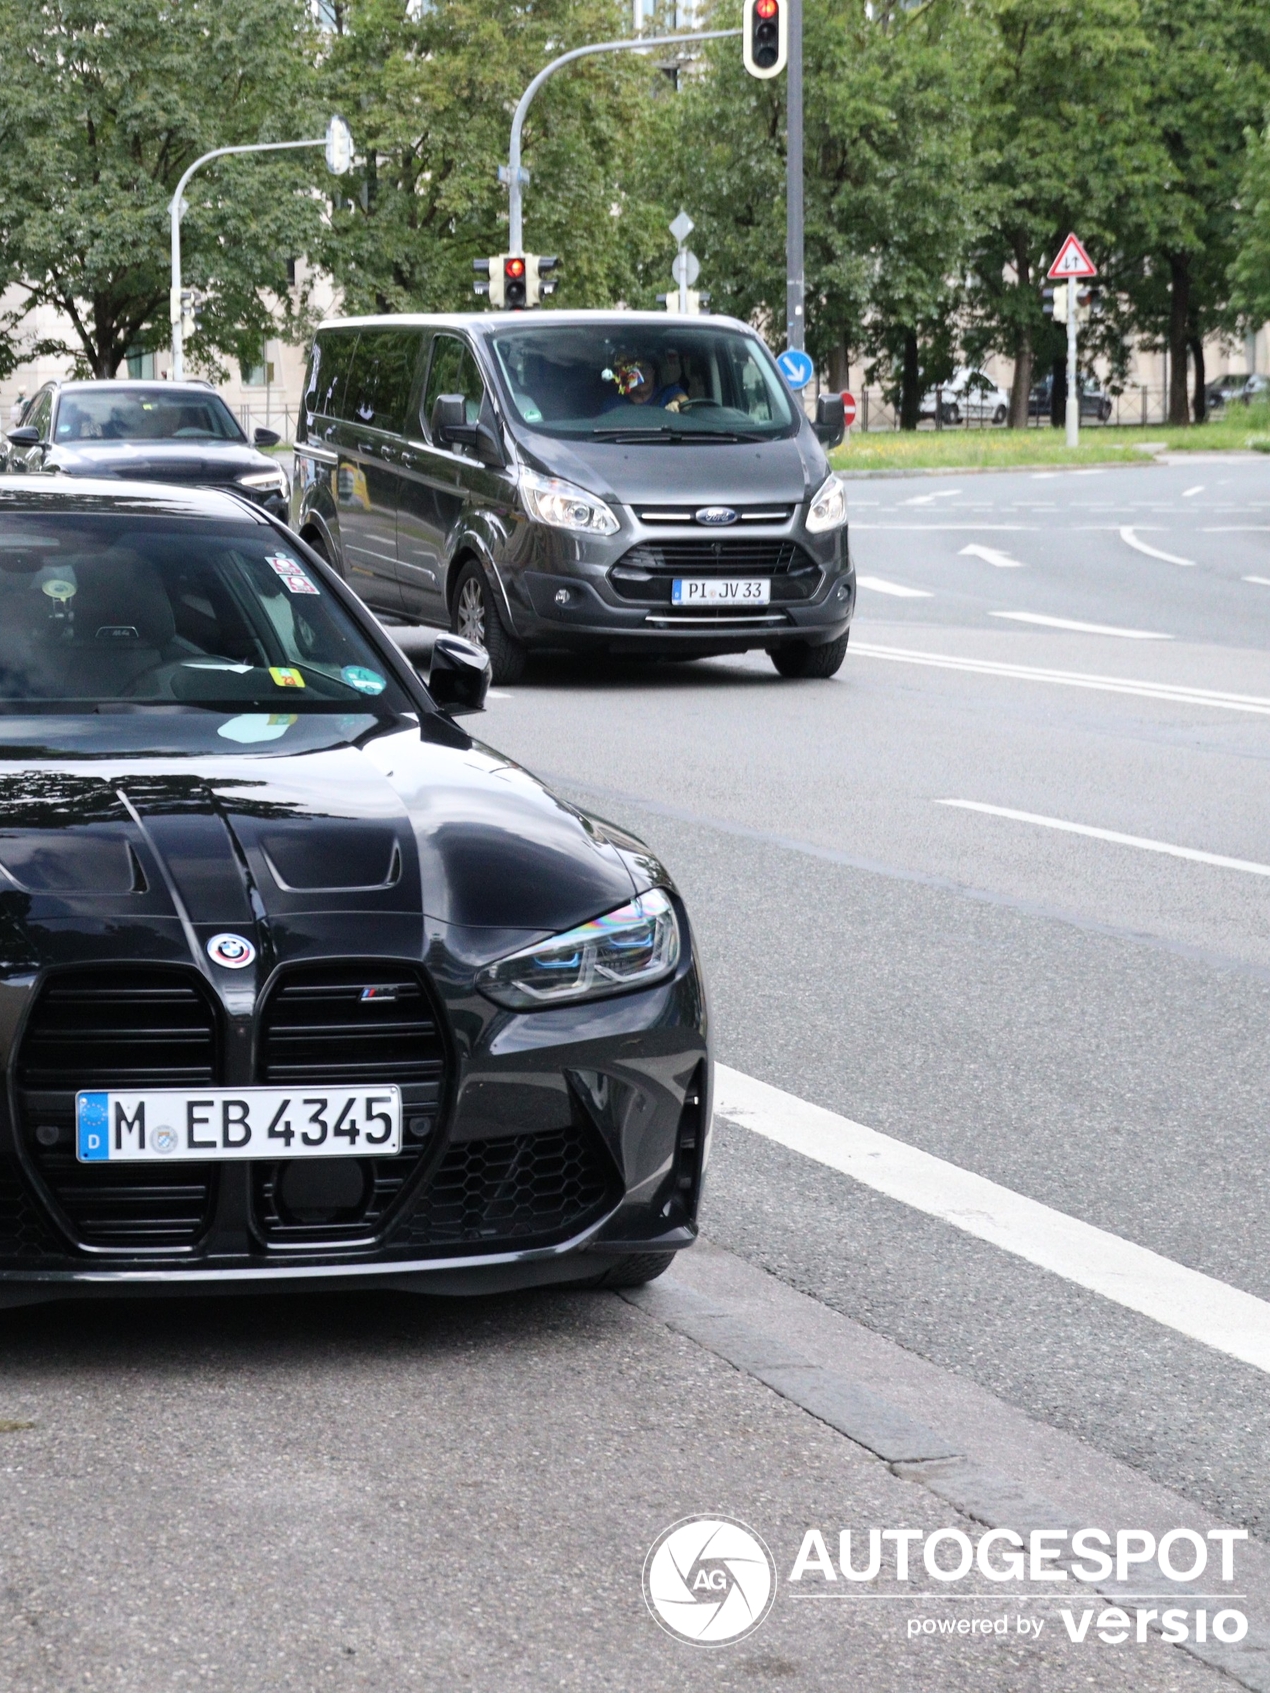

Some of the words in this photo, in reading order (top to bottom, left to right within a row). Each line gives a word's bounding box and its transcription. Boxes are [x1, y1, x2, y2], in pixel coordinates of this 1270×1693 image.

[688, 583, 707, 599] PI
[718, 583, 739, 599] JV
[742, 583, 762, 599] 33
[115, 1101, 145, 1149] M
[187, 1100, 252, 1149] EB
[267, 1096, 393, 1148] 4345
[88, 1134, 100, 1150] D
